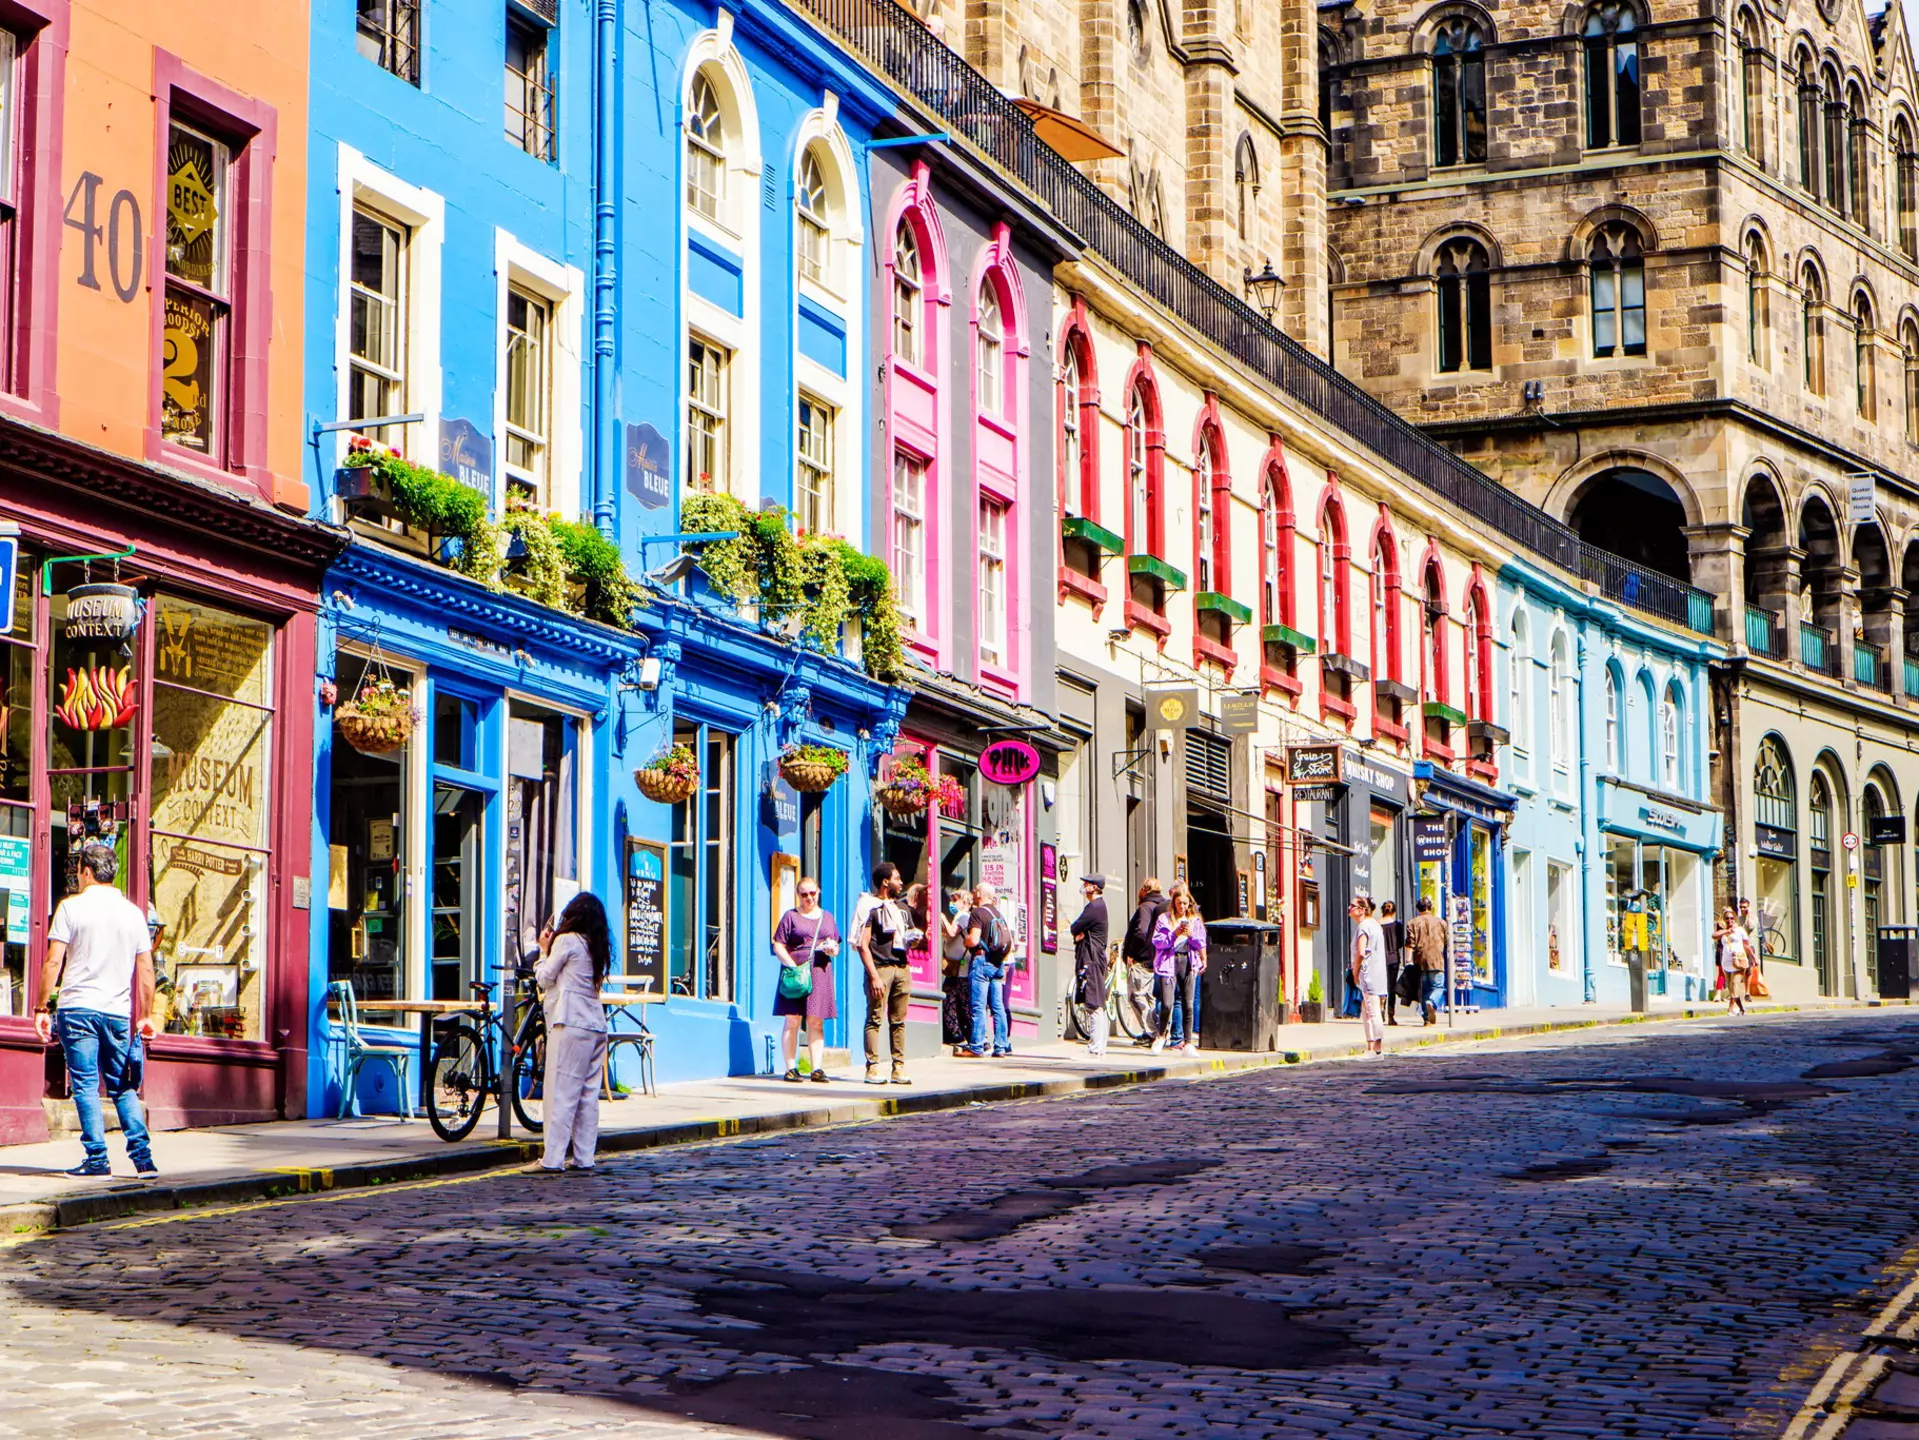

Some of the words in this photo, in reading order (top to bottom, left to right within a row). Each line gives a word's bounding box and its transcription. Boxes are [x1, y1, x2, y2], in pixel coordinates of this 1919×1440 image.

[174, 183, 207, 219] BEST
[63, 170, 142, 303] 40
[165, 297, 210, 338] PERIOR
[459, 465, 491, 496] BLEUE
[643, 470, 670, 498] BLEUE
[66, 599, 124, 620] MUSEUM
[65, 622, 123, 640] CONTEXT
[168, 752, 253, 811] MUSEUM
[1294, 787, 1335, 800] RESTAURANT
[1375, 774, 1395, 792] SHOP
[183, 798, 237, 829] CONTEXT
[775, 800, 797, 823] BLEUE
[1416, 834, 1445, 847] WHIS
